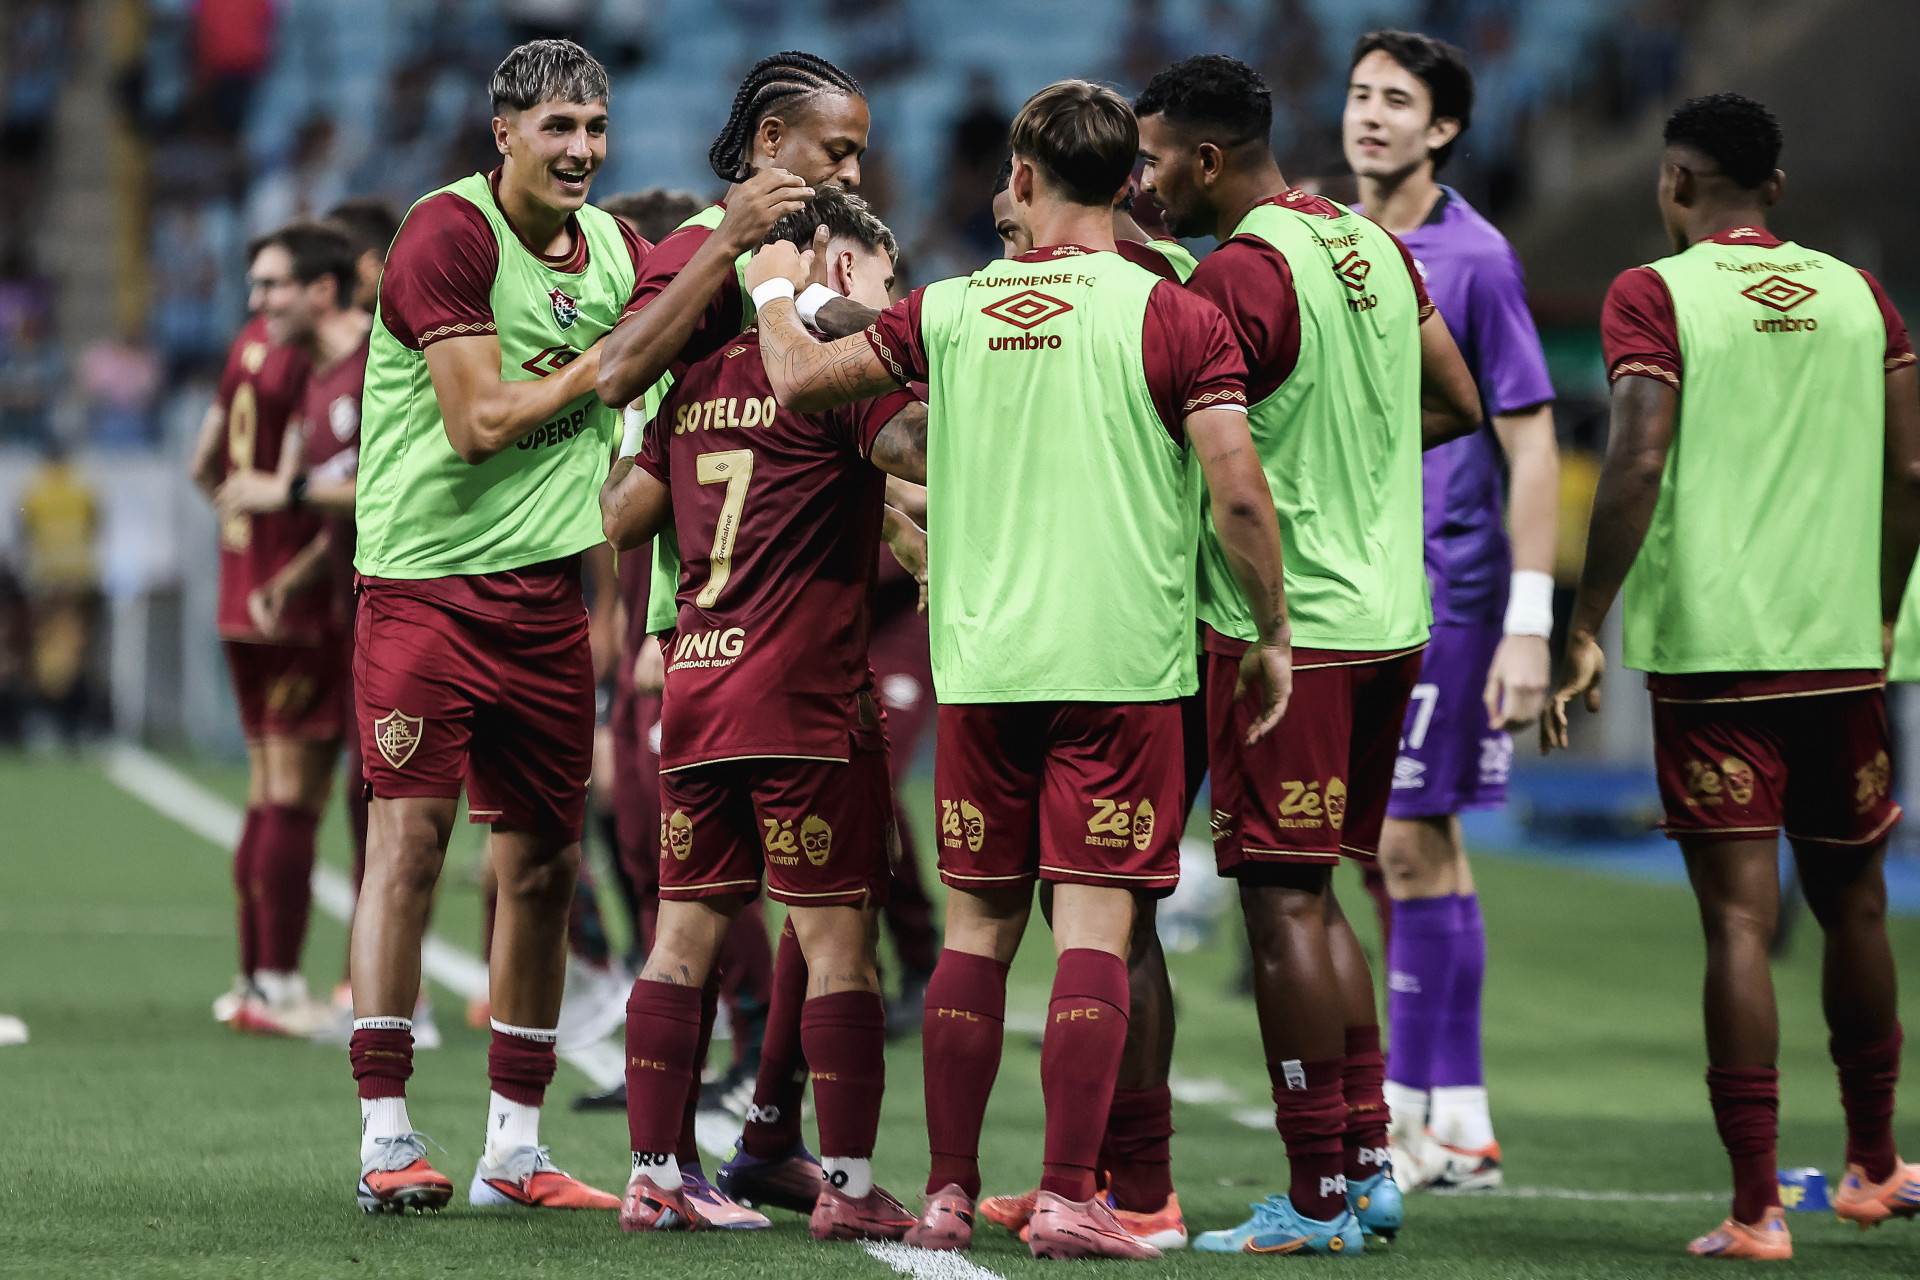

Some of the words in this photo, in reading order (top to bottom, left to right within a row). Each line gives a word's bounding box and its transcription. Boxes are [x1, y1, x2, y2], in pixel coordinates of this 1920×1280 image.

[968, 273, 1073, 288] FLUMINENSE
[1076, 274, 1097, 288] FC
[988, 332, 1062, 351] umbro
[1753, 315, 1818, 333] umbro
[674, 395, 777, 436] SOTELDO
[696, 448, 755, 609] 7
[718, 513, 734, 561] predialnet
[1398, 683, 1440, 750] 7
[1277, 780, 1324, 816] Zé
[941, 799, 963, 837] Zé
[1086, 798, 1131, 837] Zé
[763, 818, 800, 854] Zé
[1085, 835, 1130, 849] DELIVERY
[1055, 1008, 1100, 1024] FFC
[631, 1056, 666, 1071] FFC
